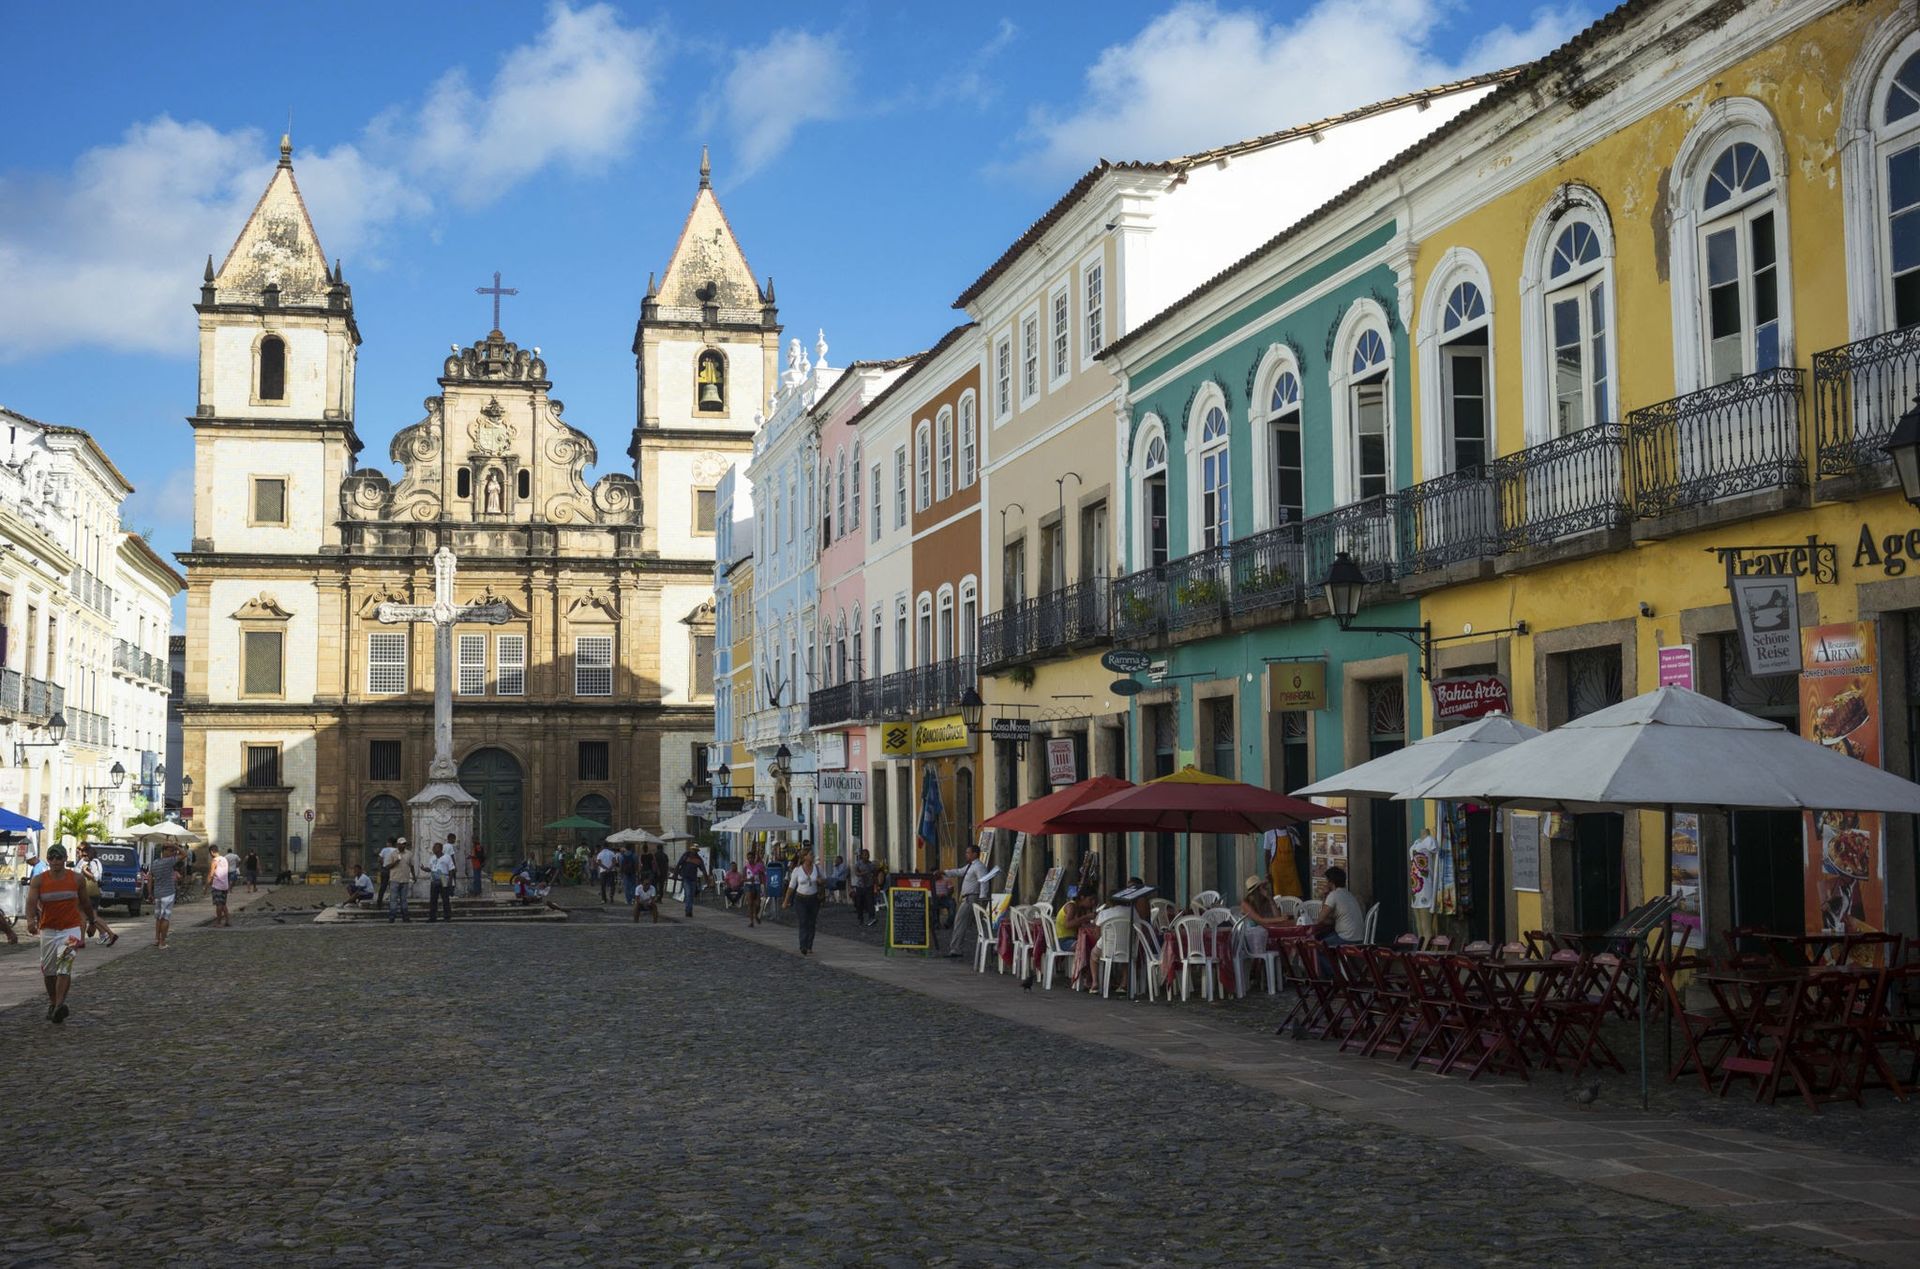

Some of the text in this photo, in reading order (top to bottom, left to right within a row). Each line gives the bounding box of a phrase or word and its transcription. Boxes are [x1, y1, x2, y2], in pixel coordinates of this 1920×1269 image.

[1718, 535, 1818, 588] Travel
[1753, 633, 1790, 647] Schöne
[1108, 654, 1140, 665] Ramma
[1757, 646, 1790, 660] Reise
[1438, 681, 1506, 702] Bahia Arte
[823, 777, 862, 789] ADVOCATUS
[850, 792, 862, 800] DEI
